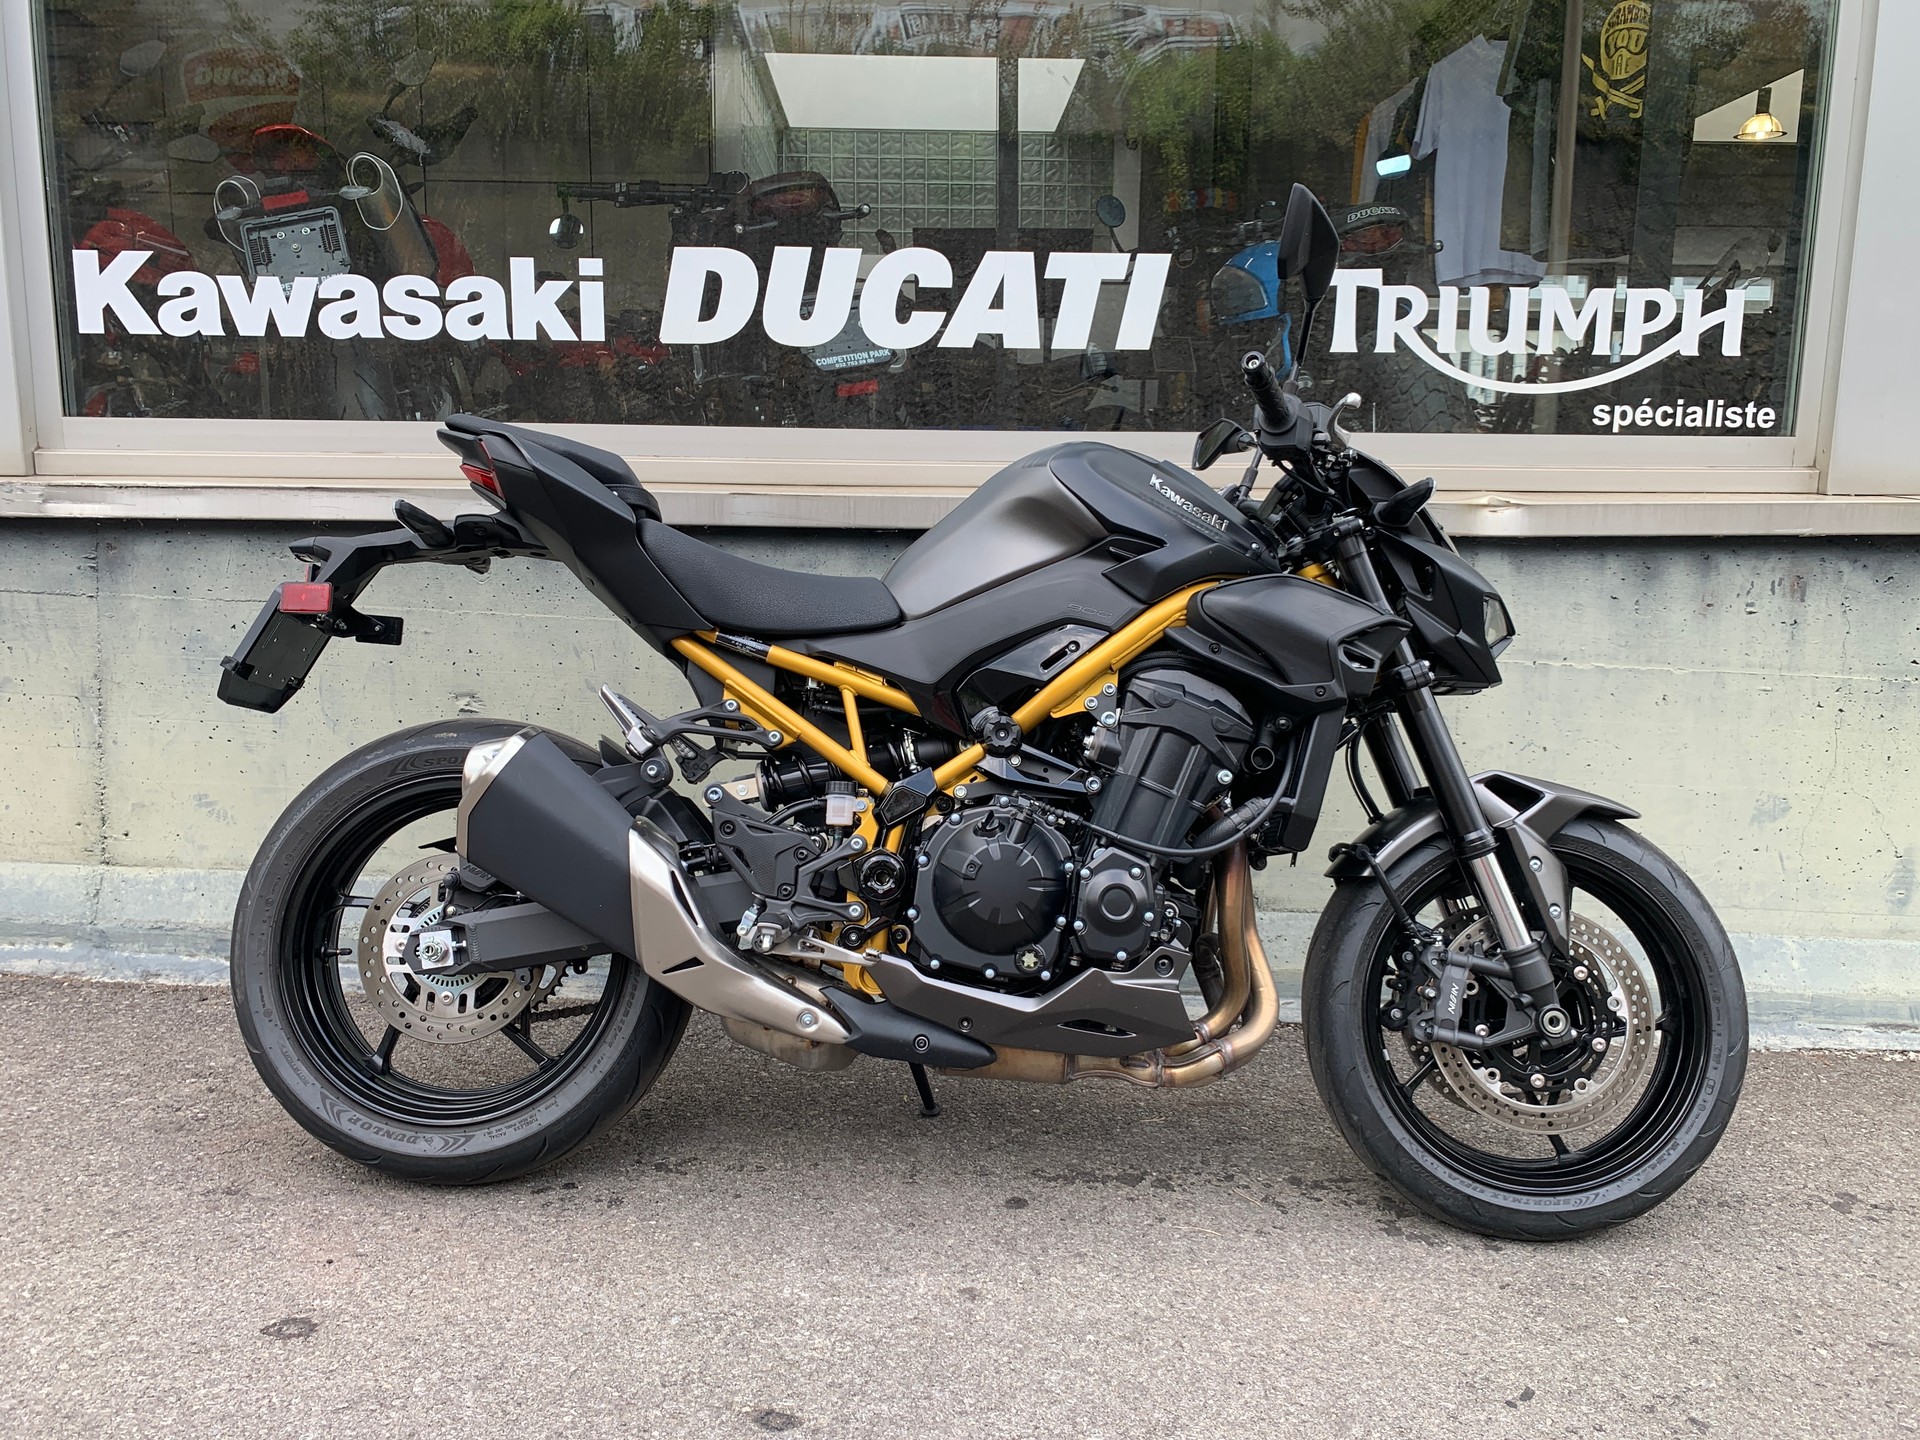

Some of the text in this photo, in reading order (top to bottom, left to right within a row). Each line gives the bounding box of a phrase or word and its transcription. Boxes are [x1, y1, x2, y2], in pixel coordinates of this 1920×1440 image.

[1347, 206, 1401, 224] DUCATI
[72, 250, 606, 341] Kawasaki
[659, 247, 1172, 351] DUCATI
[1329, 268, 1745, 394] TRIUMPH
[815, 348, 891, 366] COMPETITION PARK
[1593, 399, 1777, 433] spécialiste
[1149, 473, 1229, 532] Kawasaki
[347, 1115, 420, 1145] DUNLOP
[1491, 1192, 1571, 1207] SPORTMAX
